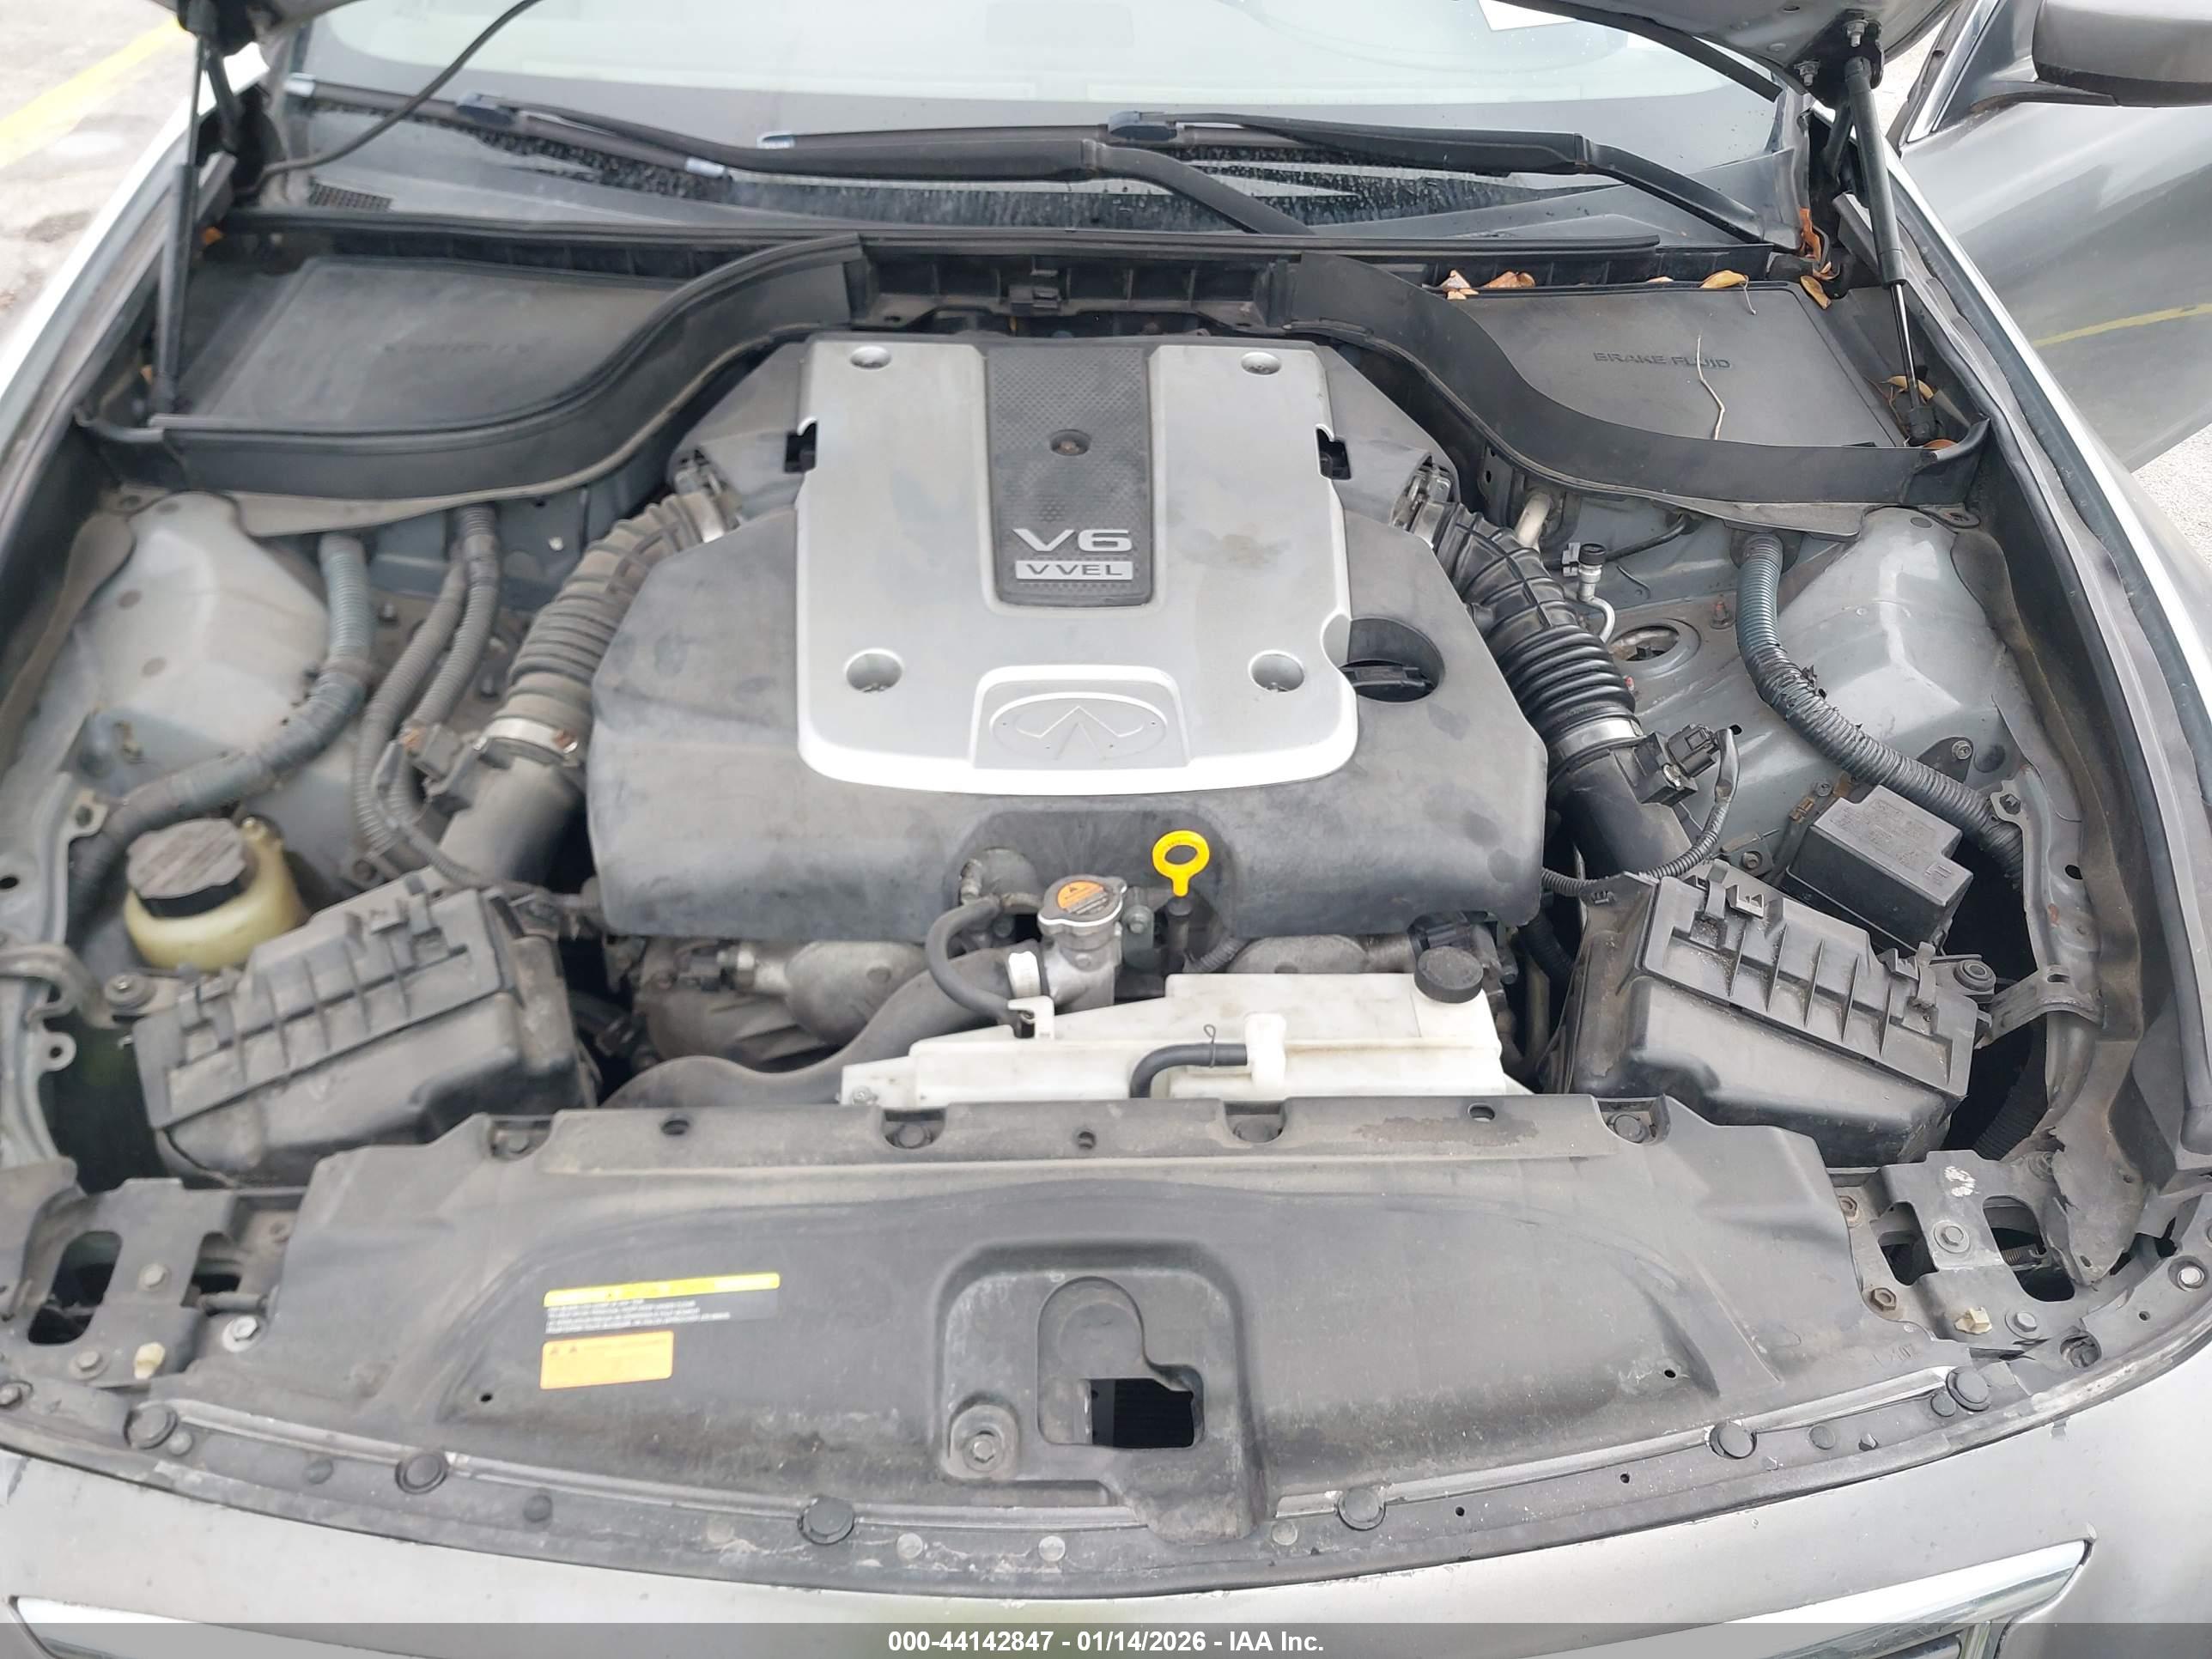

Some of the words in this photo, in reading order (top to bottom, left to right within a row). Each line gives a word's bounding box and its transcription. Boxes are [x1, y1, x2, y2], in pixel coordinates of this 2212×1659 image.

[1593, 352, 1666, 365] BRAKE
[1671, 356, 1731, 368] FLUID
[1012, 528, 1133, 552] V6
[1026, 563, 1123, 576] VVEL
